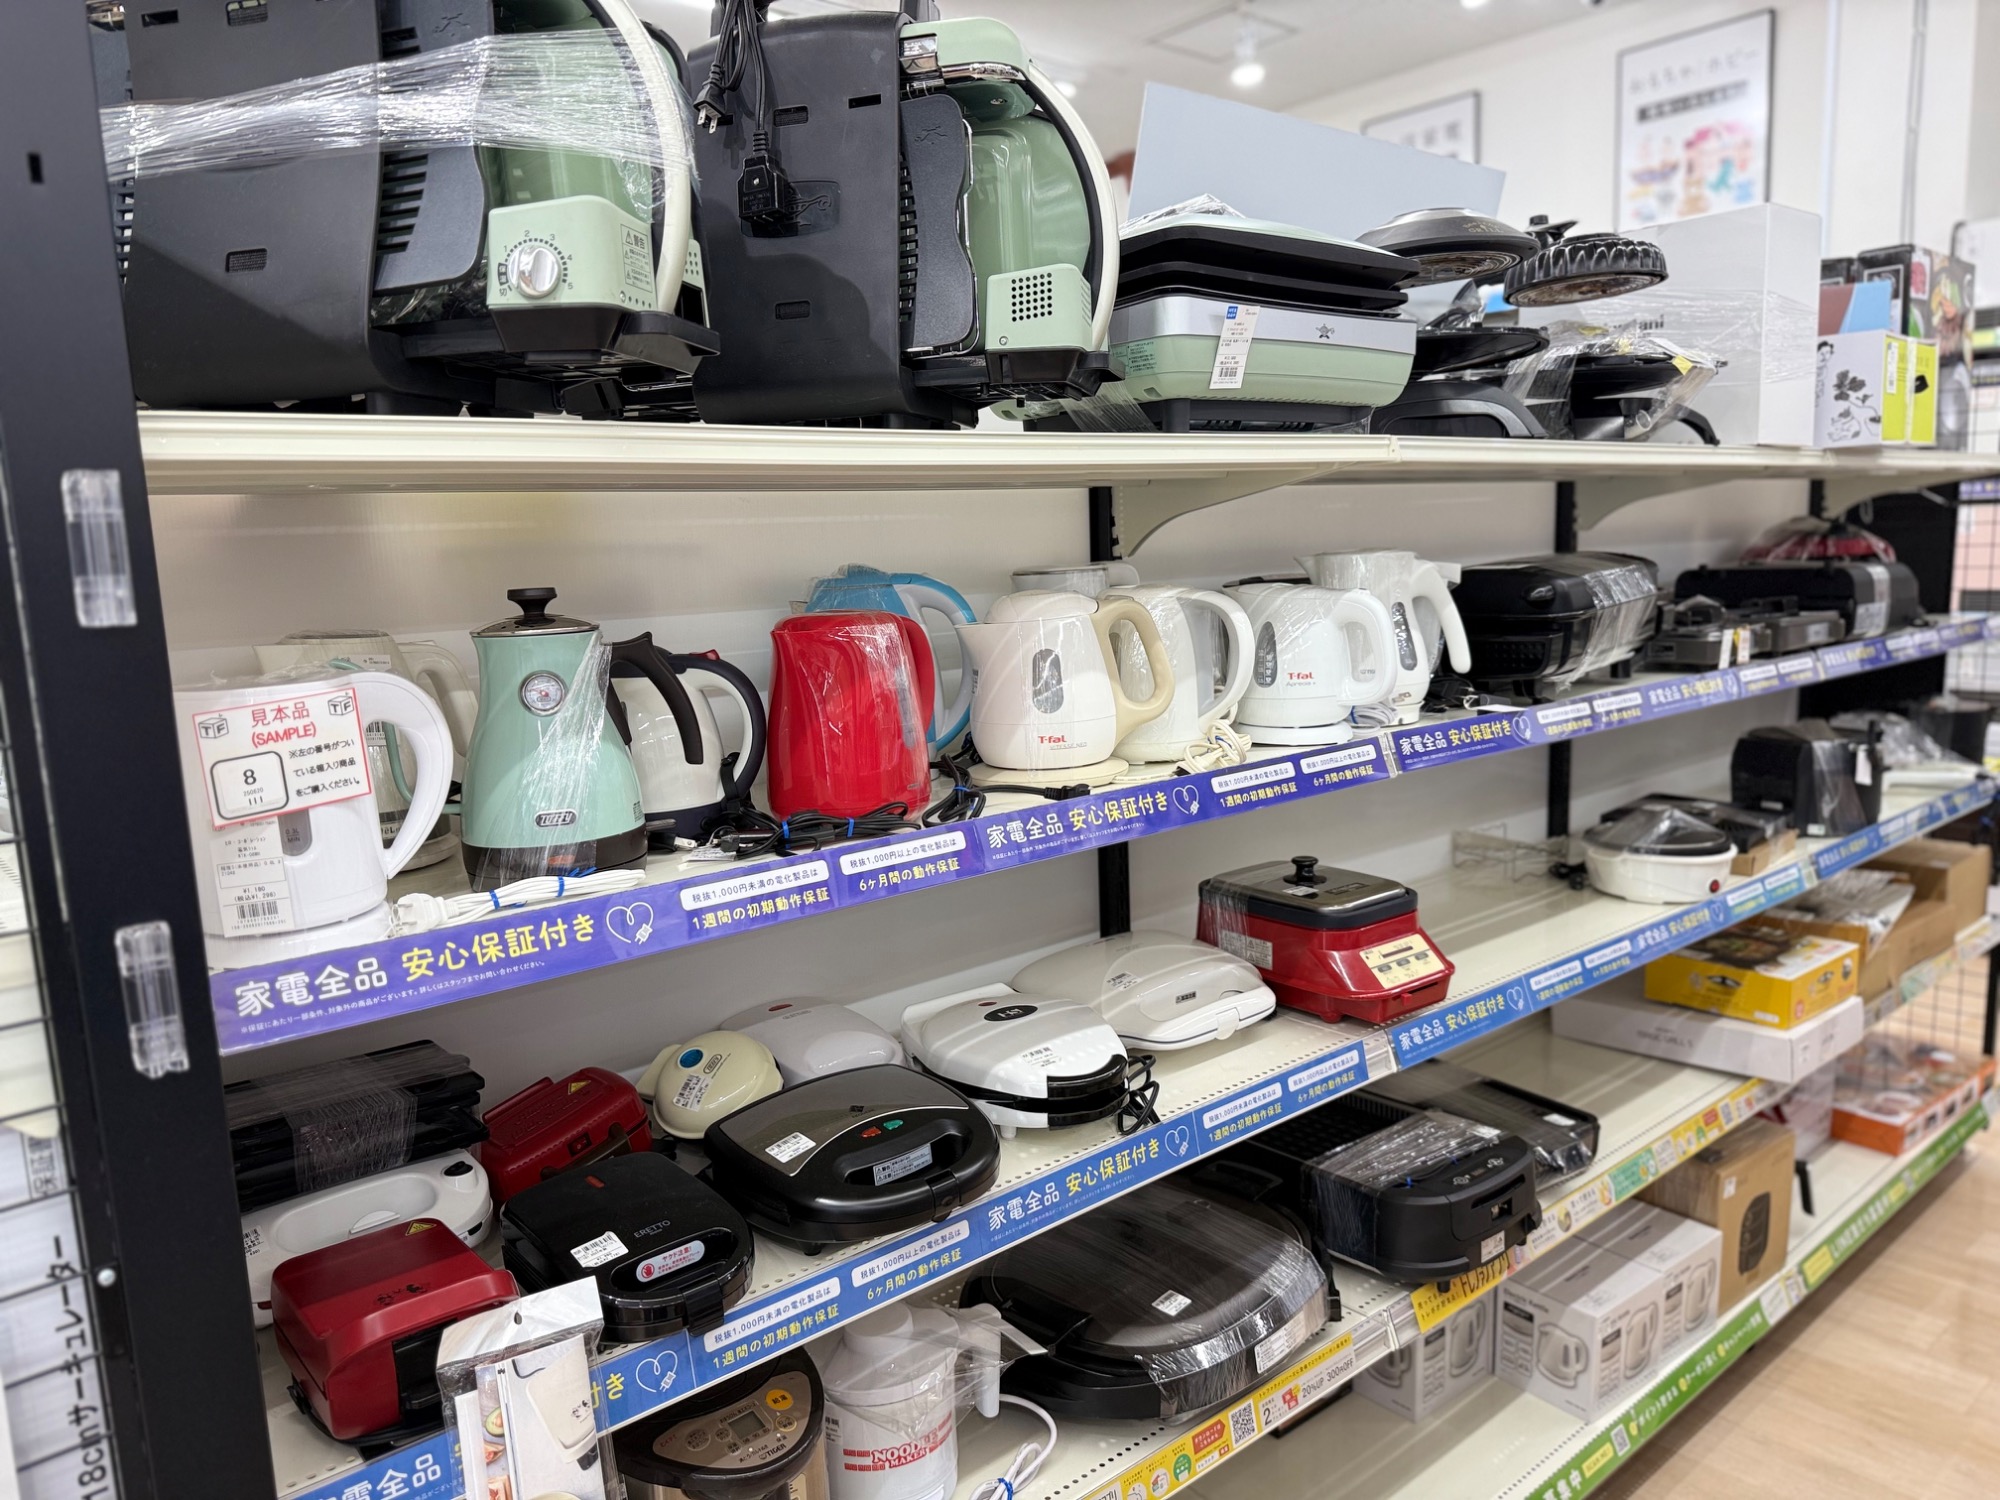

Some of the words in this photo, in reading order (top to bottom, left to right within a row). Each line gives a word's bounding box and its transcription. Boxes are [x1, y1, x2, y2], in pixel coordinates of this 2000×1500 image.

[1287, 672, 1315, 680] T-fal
[251, 701, 310, 728] 見本品
[252, 721, 317, 748] (SAMPLE)
[1038, 735, 1067, 744] T-fal
[1399, 730, 1447, 756] 家電全品
[1448, 718, 1512, 748] 安心保証付き
[289, 739, 355, 760] ※左の番号がつい
[243, 768, 257, 786] 8
[293, 757, 356, 778] ている箱入り商品
[296, 776, 361, 798] をご購入ください。
[1220, 781, 1298, 808] 1週間の初期動作保証
[986, 812, 1064, 849] 家電全品
[1068, 790, 1169, 832] 安心保証付き
[849, 837, 958, 868] 税抜1,000円以上の電化製品は
[691, 867, 820, 903] 税抜1,000円未満の電化製品は
[692, 886, 831, 930] 1週間の初期動作保証
[235, 956, 389, 1018] 家電全品
[402, 912, 596, 983] 安心保証付き
[1398, 1019, 1444, 1051] 家電全品
[1445, 994, 1505, 1032] 安心保証付き
[1208, 1103, 1282, 1142] 1週間の初期動作保証
[988, 1182, 1060, 1232] 家電全品
[1066, 1138, 1160, 1197] 安心保証付き
[634, 1219, 671, 1238] ERETTO
[860, 1229, 962, 1281] 税抜1,000円以上の電化製品は
[714, 1286, 831, 1344] 税抜1,000円未満の電化製品は
[713, 1303, 839, 1369] 1週間の初期動作保証
[772, 1394, 788, 1404] 給湯
[1263, 1407, 1273, 1426] 2
[767, 1443, 787, 1457] TIGER
[889, 1448, 928, 1468] MAKER
[319, 1452, 442, 1500] 電全品
